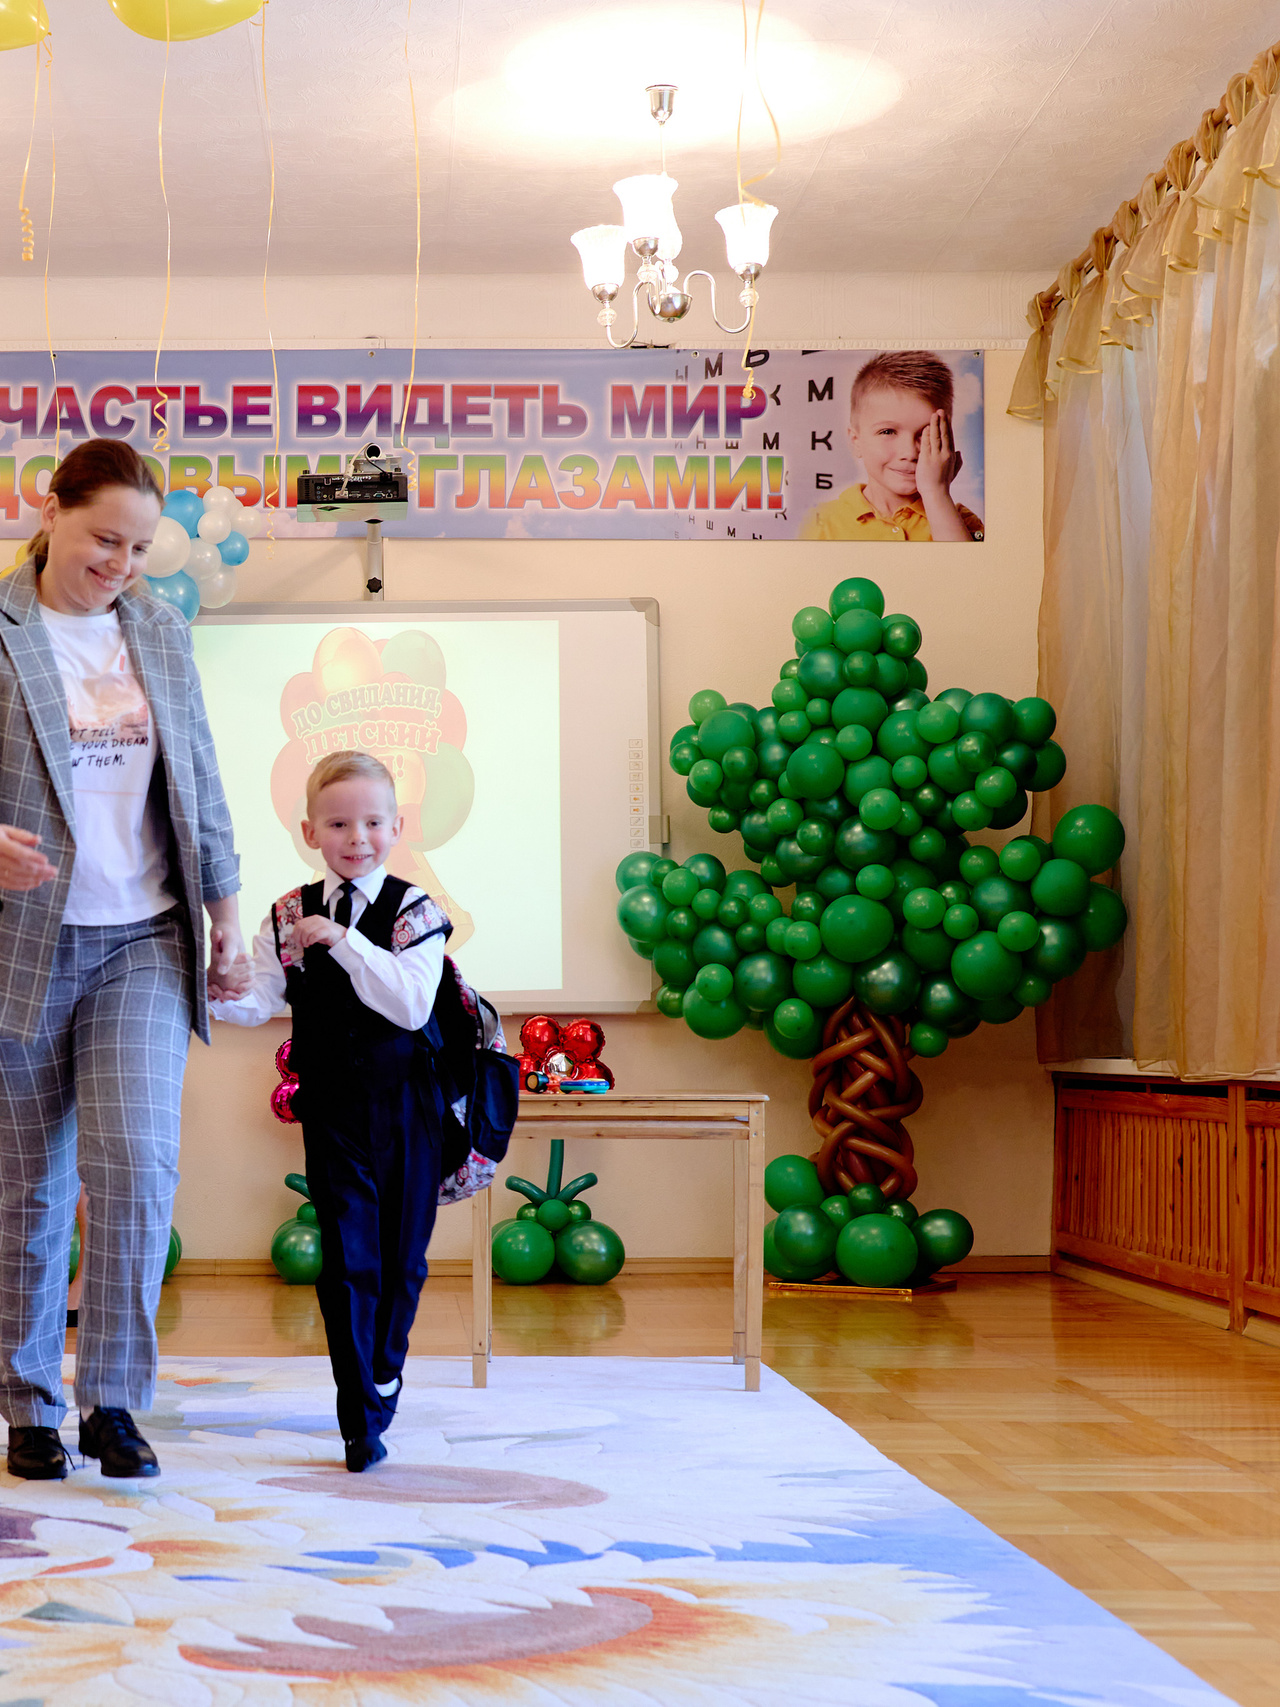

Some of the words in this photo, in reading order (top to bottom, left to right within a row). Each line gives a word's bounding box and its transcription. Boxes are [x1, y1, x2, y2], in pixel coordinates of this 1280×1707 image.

[808, 376, 834, 402] М
[296, 383, 589, 448] ВИДЕТЬ
[610, 384, 768, 439] МИР
[762, 432, 780, 450] М
[811, 430, 833, 451] К
[418, 454, 784, 510] ГЛАЗАМИ!
[815, 473, 833, 490] Б
[292, 703, 322, 738] ДО
[326, 683, 442, 718] СВИДАНИЯ,
[82, 739, 107, 751] YOUR
[304, 720, 441, 763] ДЕТСКИЙ
[87, 754, 126, 768] THEM.
